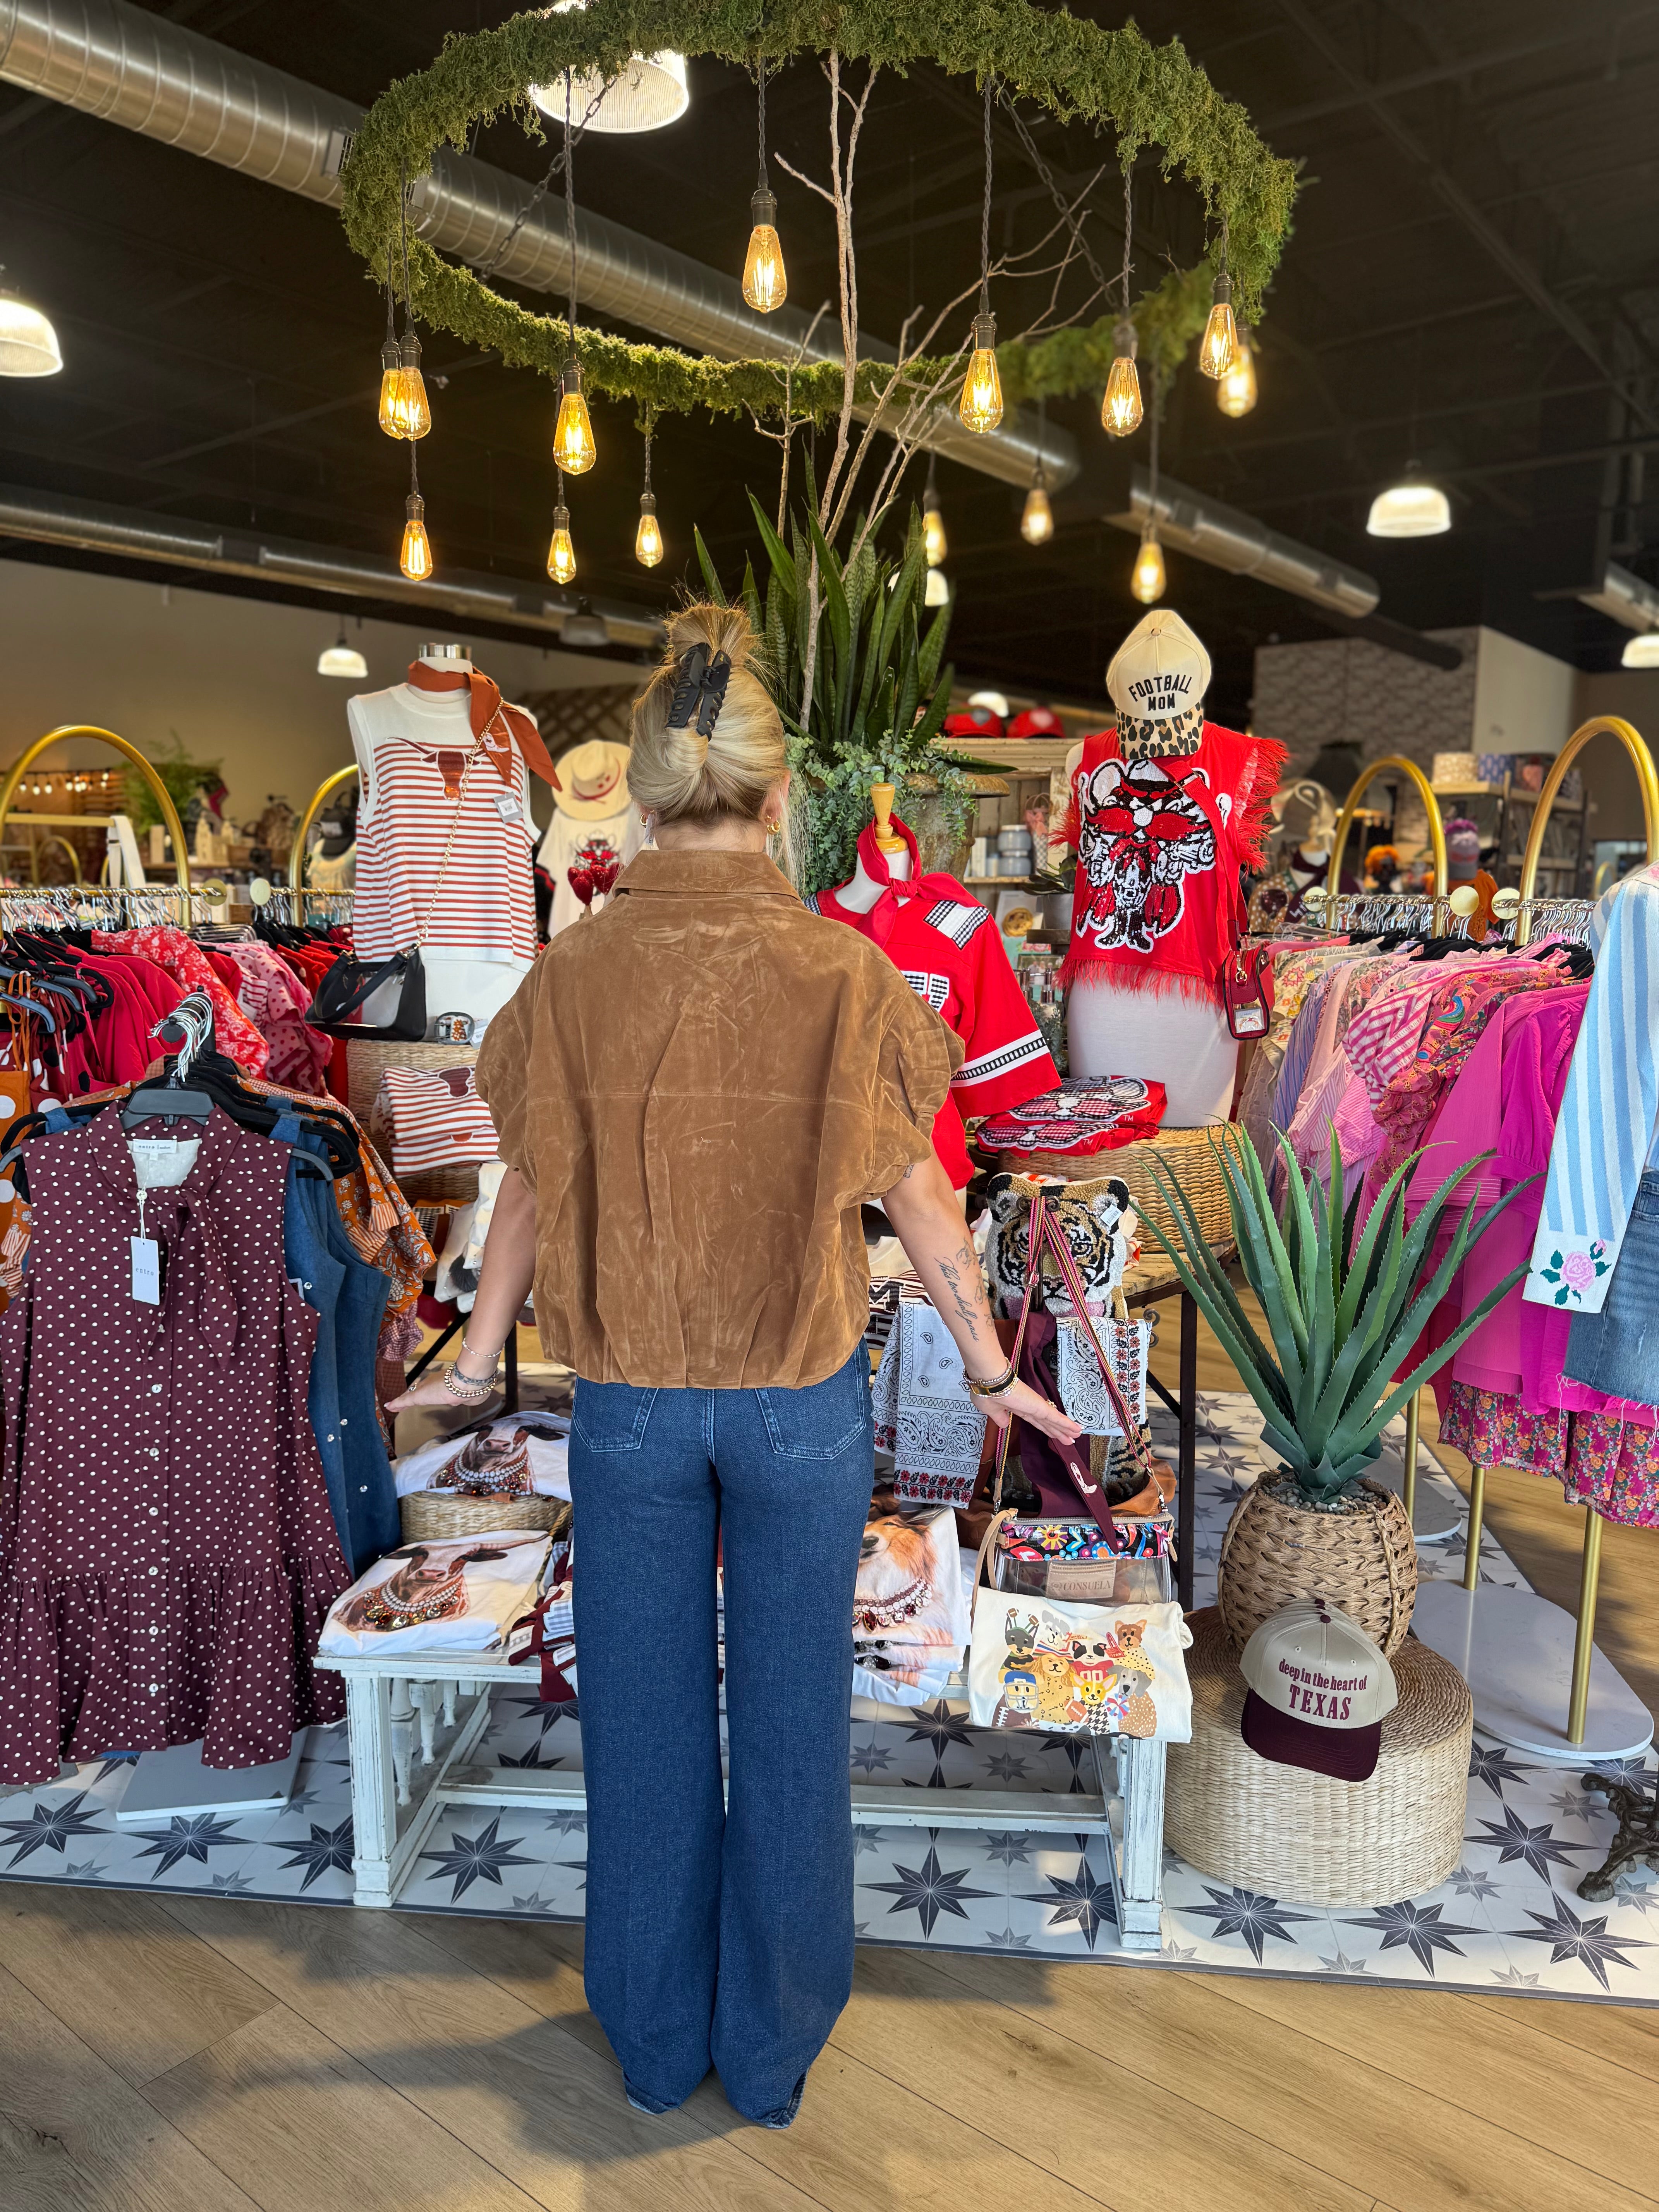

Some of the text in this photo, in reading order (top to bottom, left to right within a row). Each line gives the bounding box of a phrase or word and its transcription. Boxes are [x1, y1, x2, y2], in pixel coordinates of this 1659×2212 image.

[1128, 674, 1192, 702] FOOTBALL
[1148, 693, 1175, 711] MOM
[136, 1267, 154, 1276] entro
[934, 1257, 979, 1341] This too shall pass
[1063, 1580, 1111, 1591] CONSUELA
[1279, 1658, 1367, 1691] deep in the heart of
[1289, 1683, 1352, 1720] TEXAS
